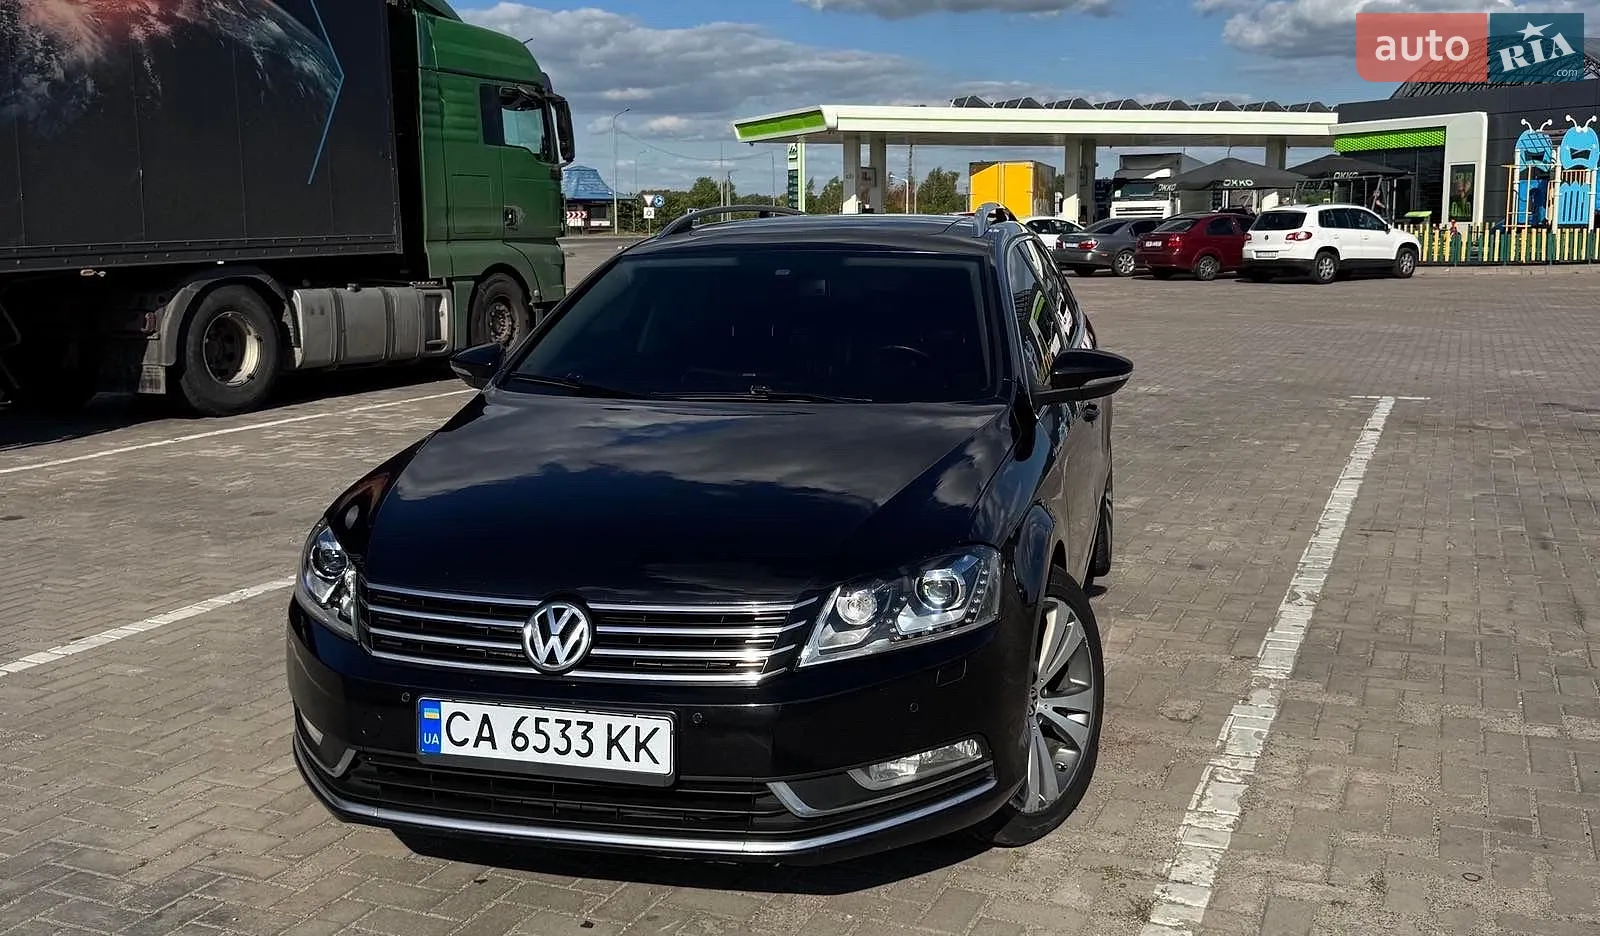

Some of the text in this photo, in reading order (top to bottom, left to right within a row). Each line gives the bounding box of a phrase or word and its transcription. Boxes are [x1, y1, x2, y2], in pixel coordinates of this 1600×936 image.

[423, 732, 440, 745] UA
[445, 711, 661, 765] CA 6533 KK
